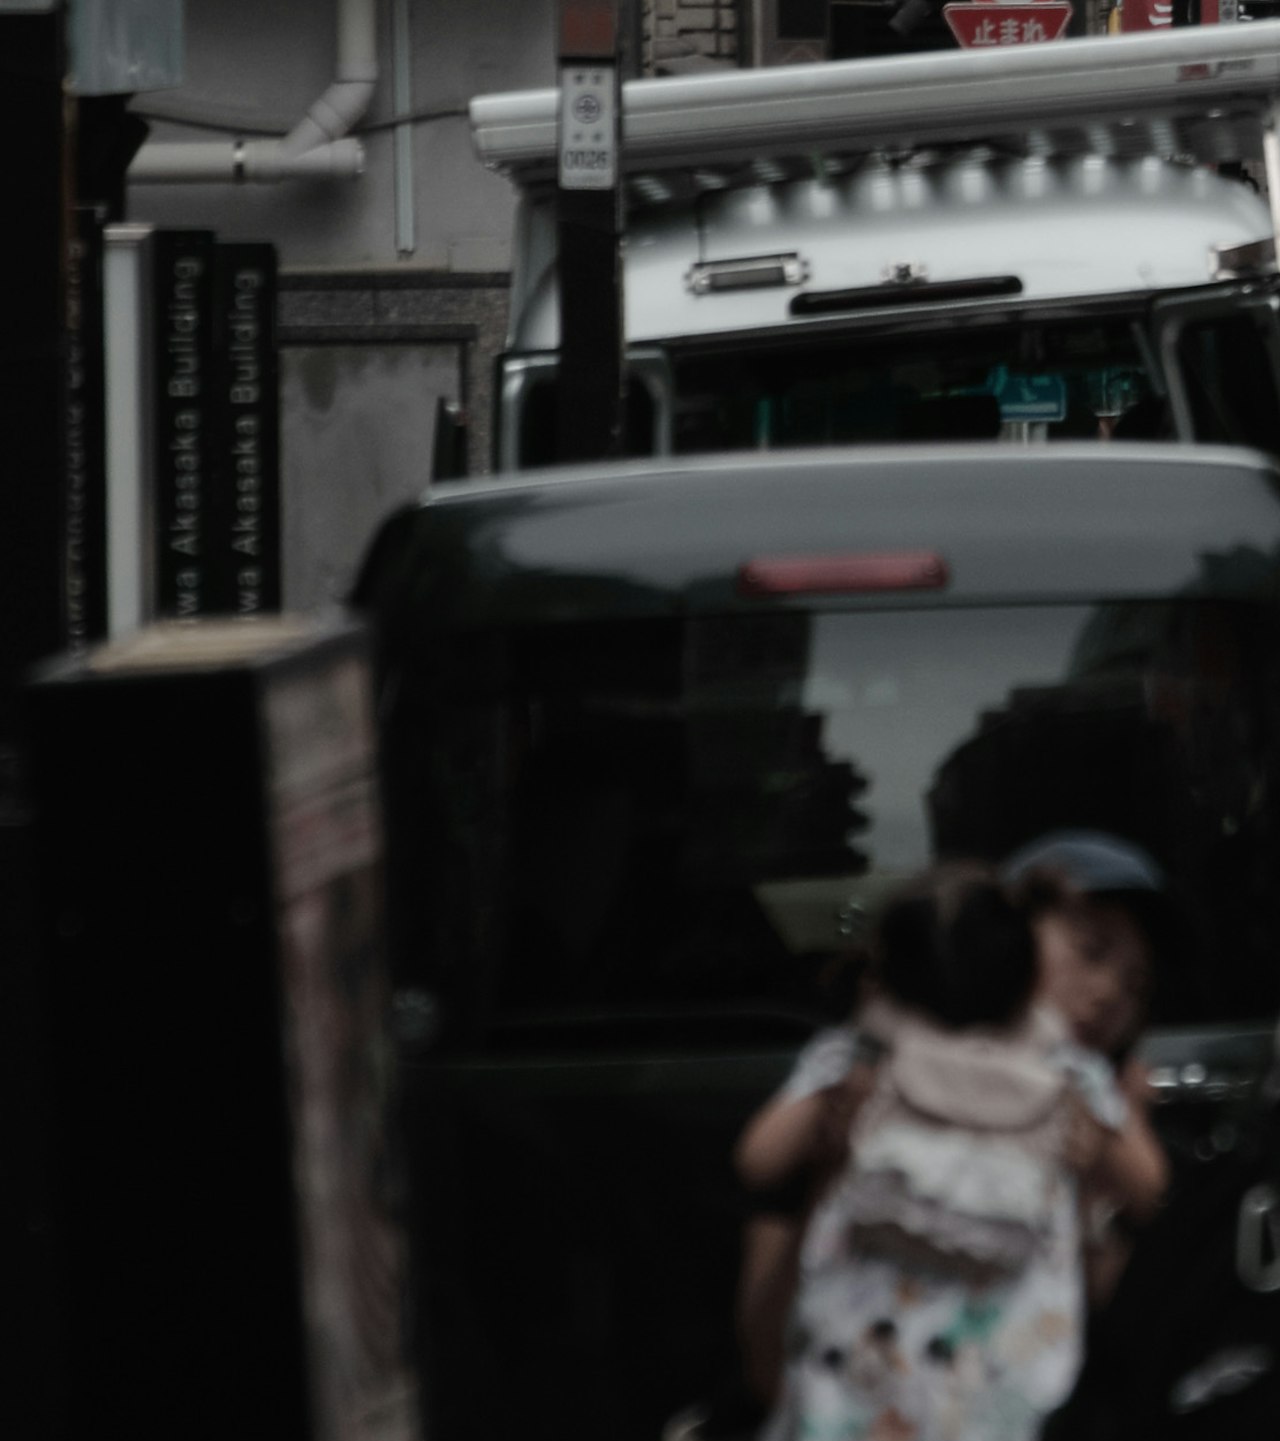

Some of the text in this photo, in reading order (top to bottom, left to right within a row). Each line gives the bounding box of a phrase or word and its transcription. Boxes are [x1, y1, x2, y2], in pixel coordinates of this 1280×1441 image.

[971, 18, 1048, 46] 止まれ
[167, 254, 204, 556] Akasaka Building
[229, 268, 264, 557] Akasaka Building
